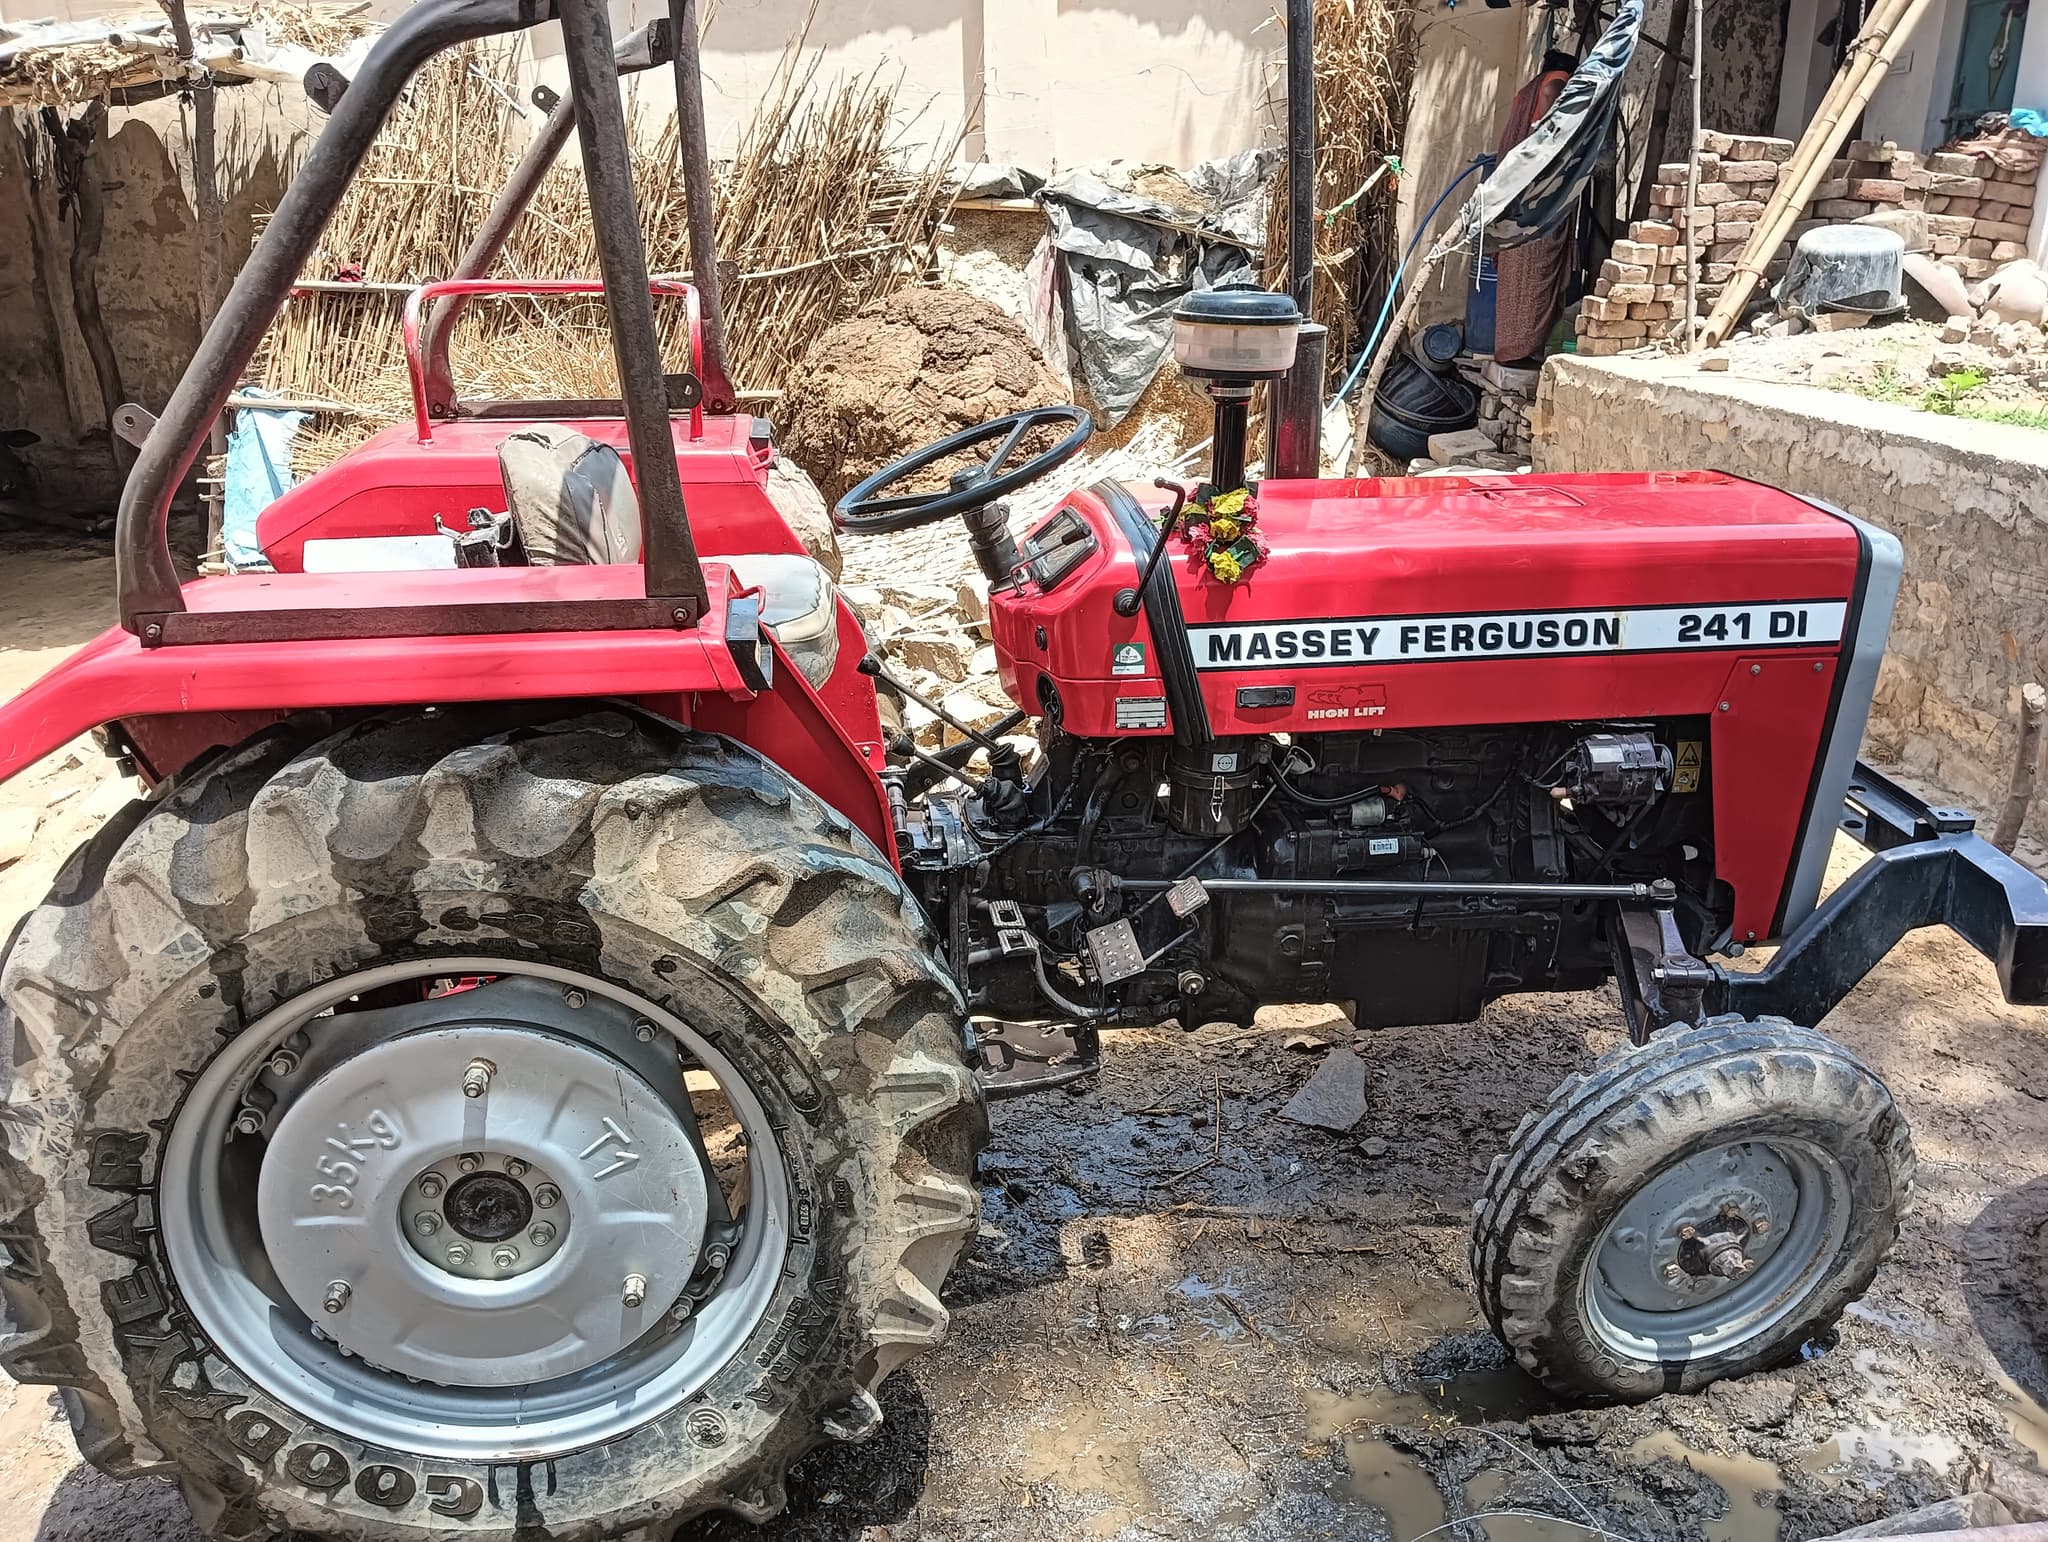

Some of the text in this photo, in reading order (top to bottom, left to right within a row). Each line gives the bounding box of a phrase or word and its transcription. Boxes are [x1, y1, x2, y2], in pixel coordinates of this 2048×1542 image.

[1207, 610, 1808, 662] MASSEY FERGUSON 241 DI
[1307, 706, 1386, 720] HIGH LIFT
[579, 1116, 640, 1180] T1
[87, 1130, 484, 1517] GOODYEAR
[744, 1276, 841, 1404] VAJRA
[755, 1296, 804, 1369] SUPER
